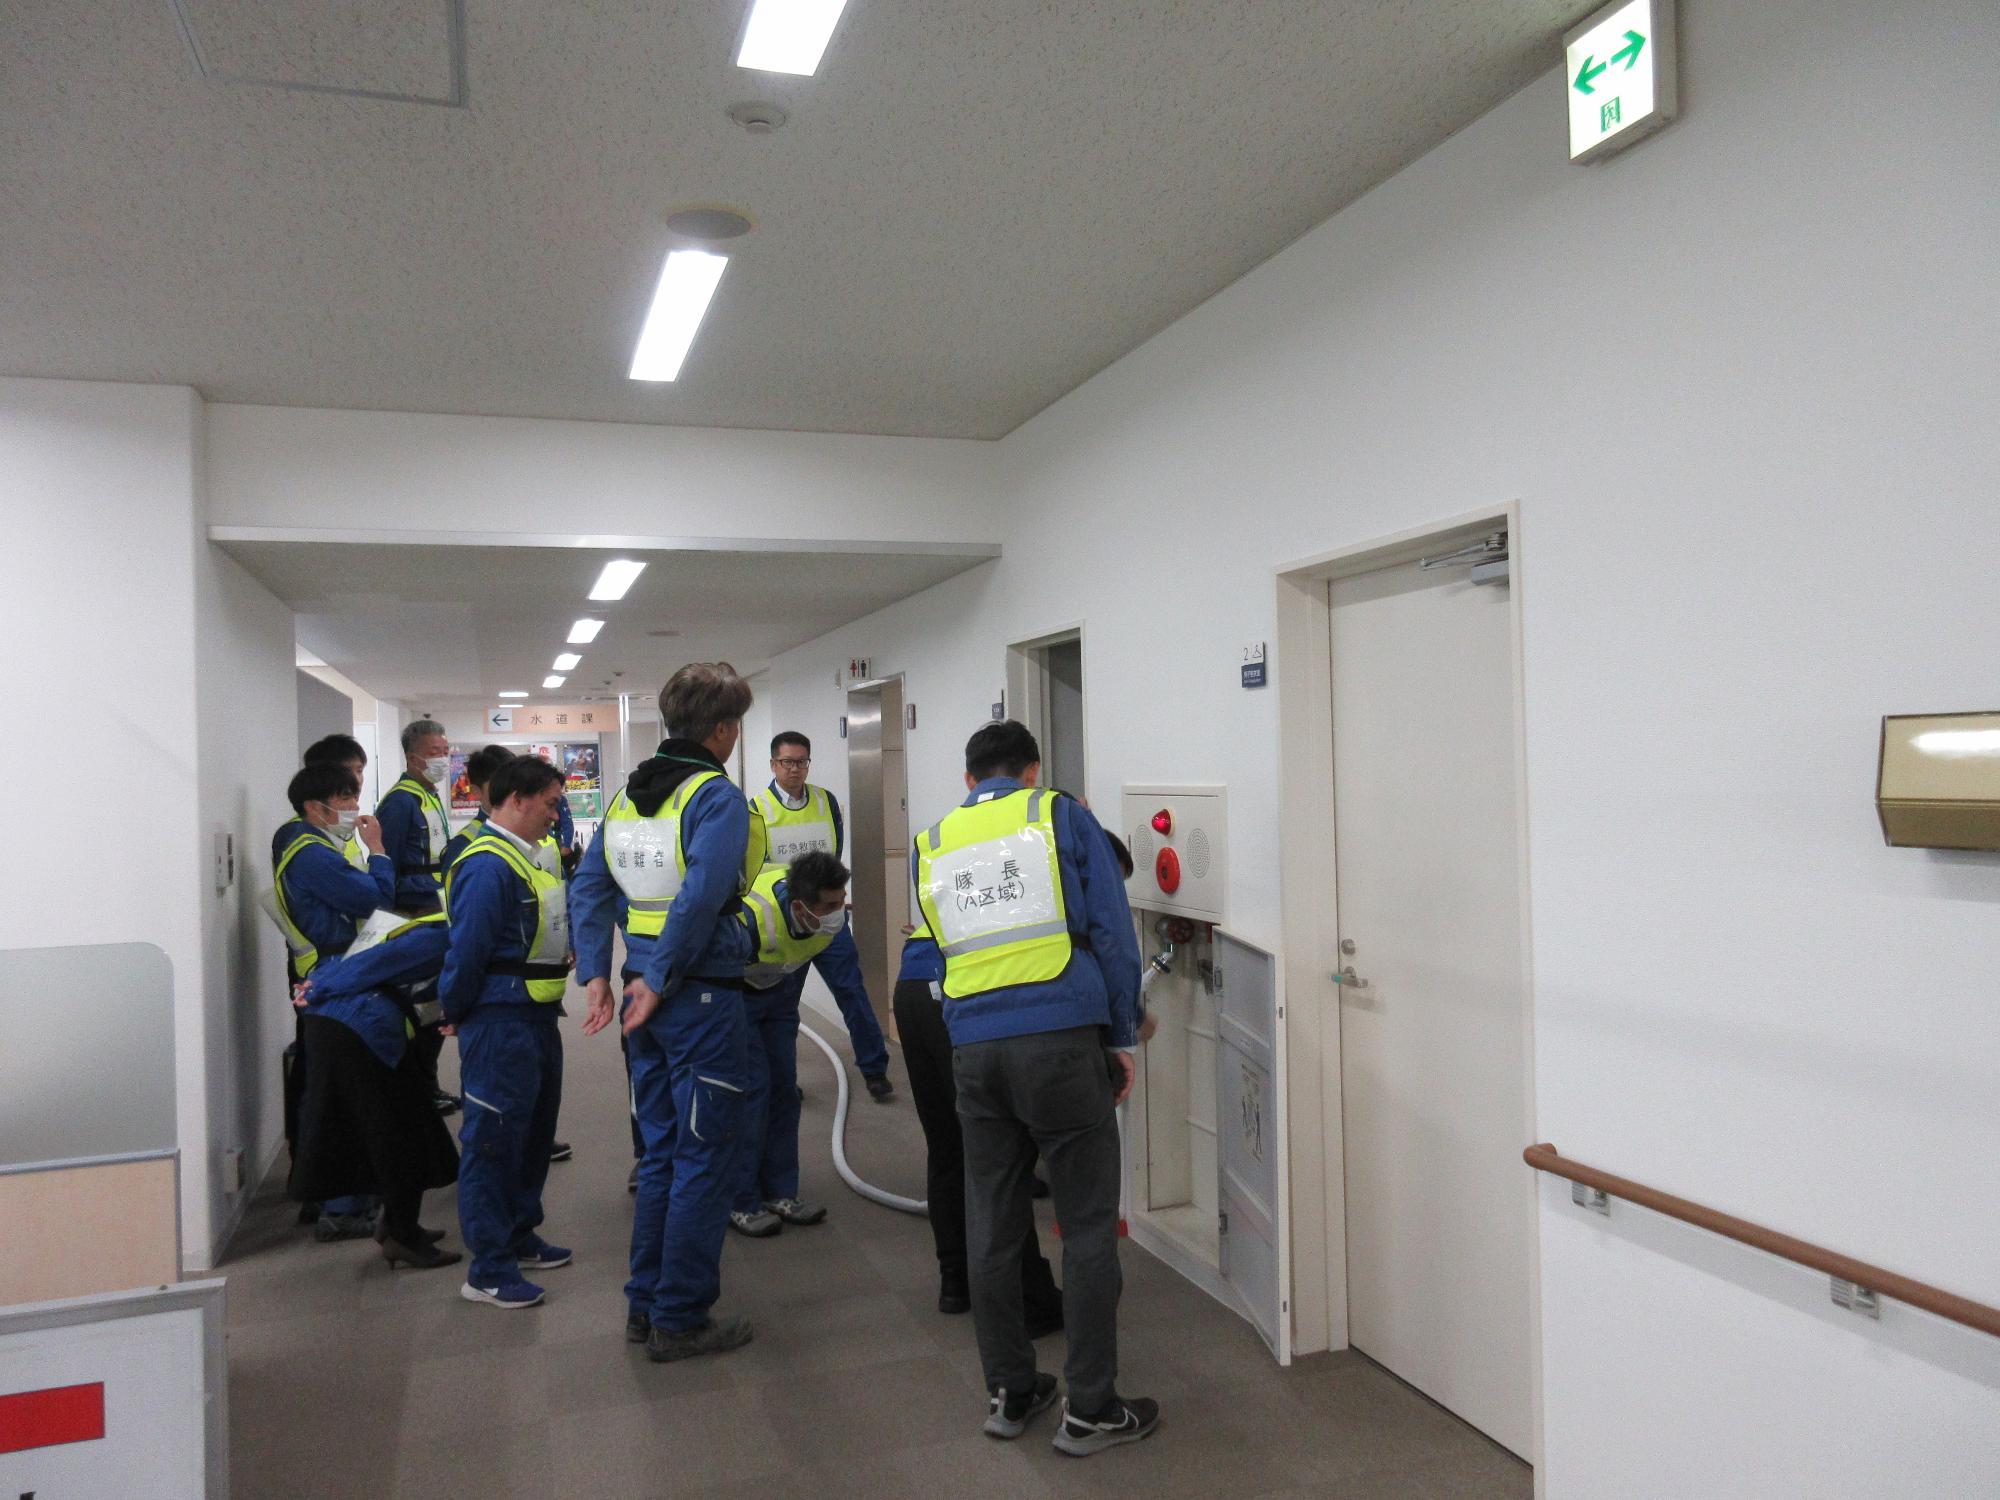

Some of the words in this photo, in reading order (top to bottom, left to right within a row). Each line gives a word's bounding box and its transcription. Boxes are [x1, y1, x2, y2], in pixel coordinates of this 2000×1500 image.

[1243, 647, 1249, 661] 2
[530, 713, 593, 725] 水道課
[616, 849, 665, 869] 避難者
[955, 859, 1020, 891] 隊長
[956, 881, 1024, 912] (A区域)
